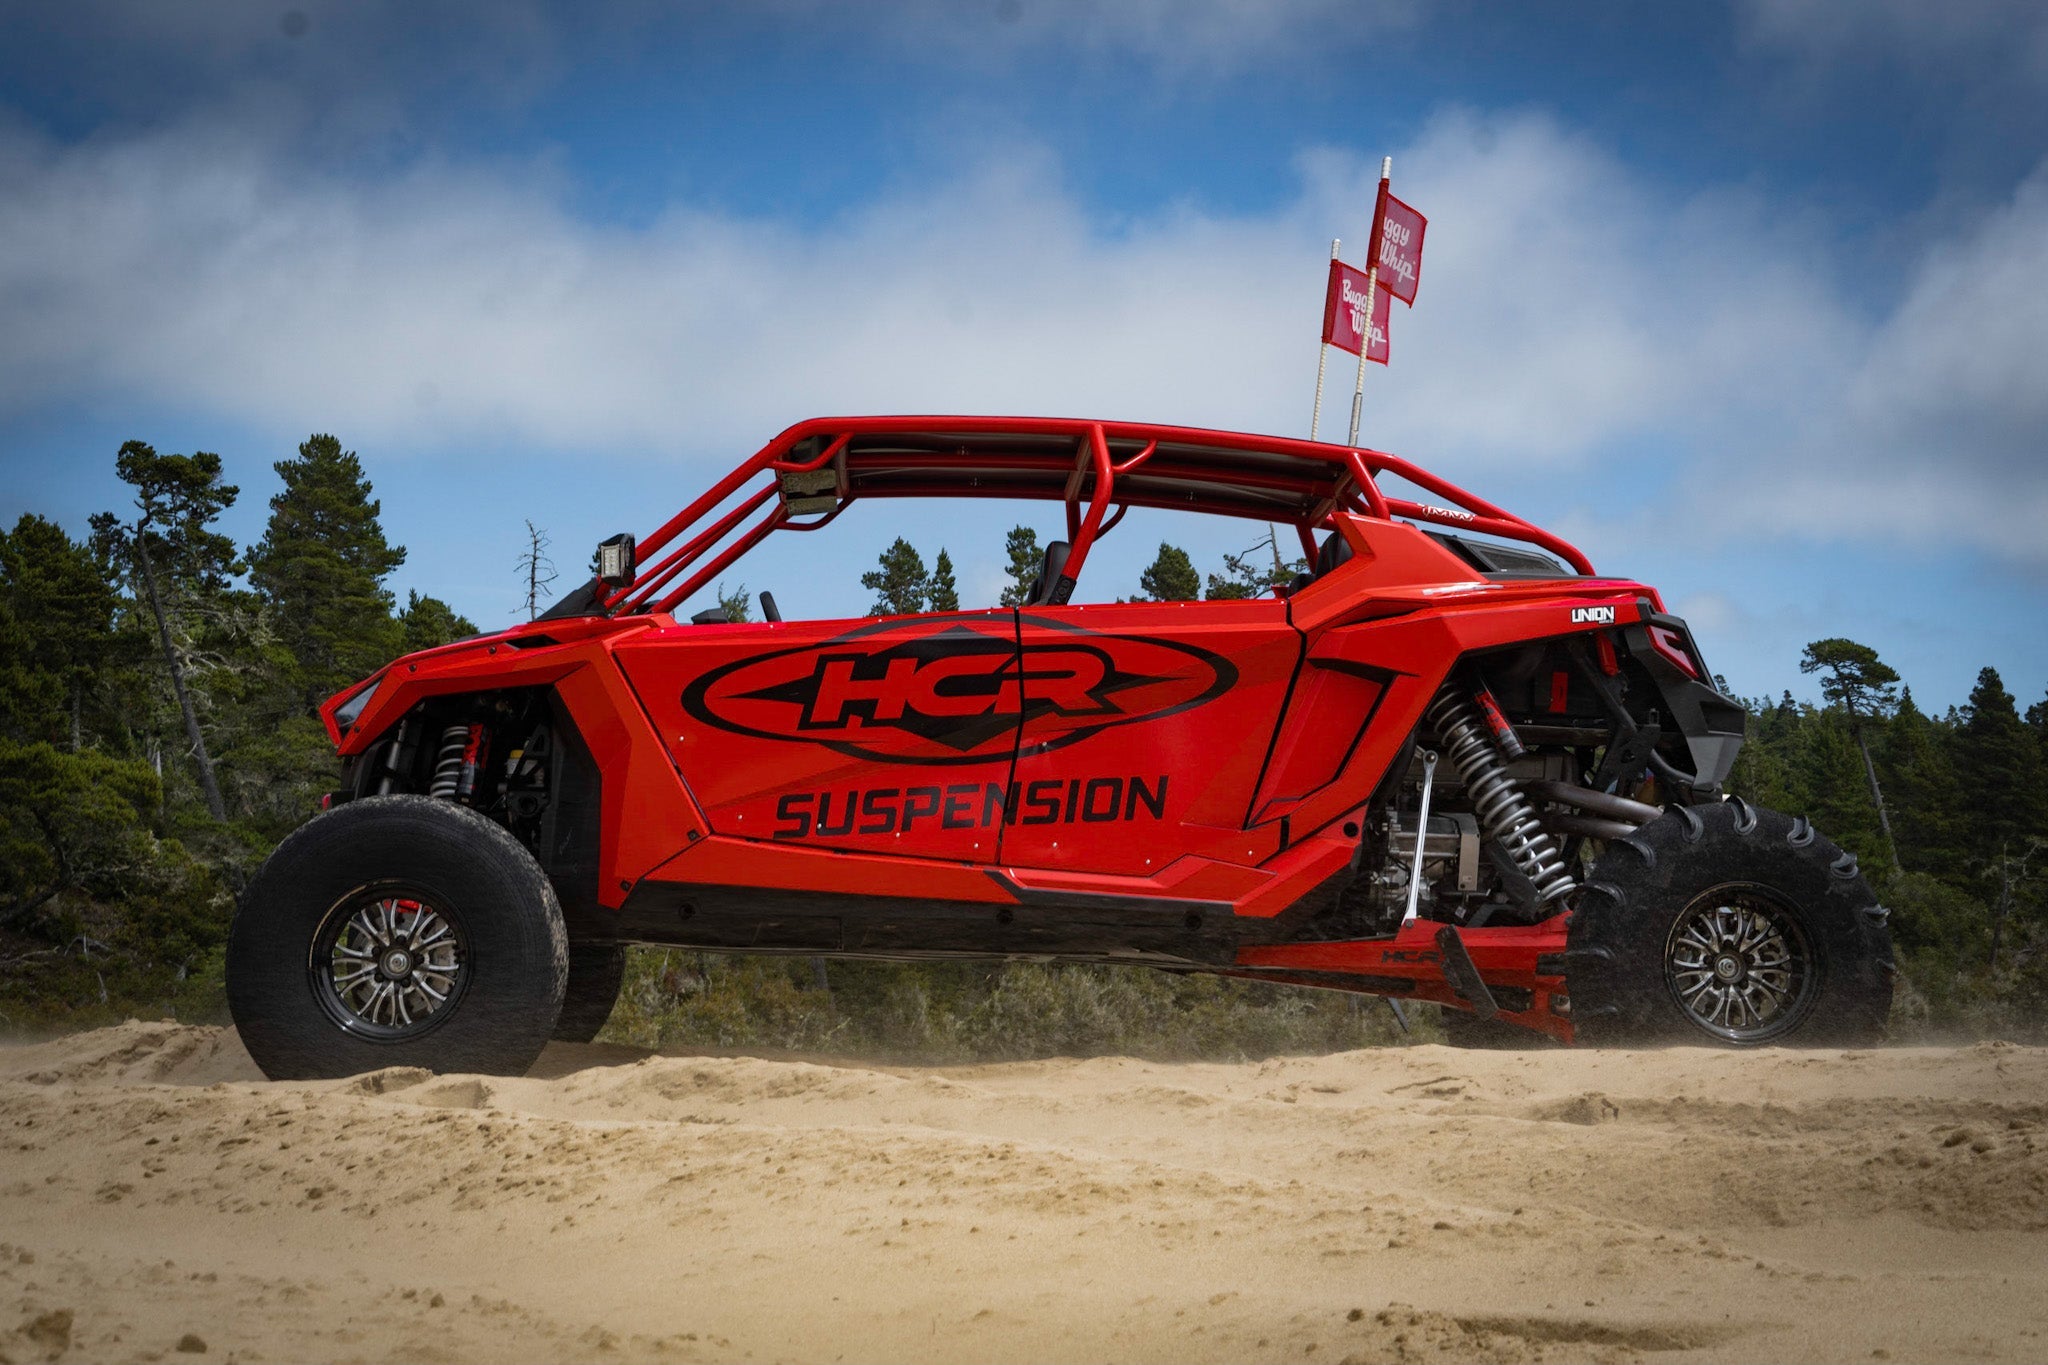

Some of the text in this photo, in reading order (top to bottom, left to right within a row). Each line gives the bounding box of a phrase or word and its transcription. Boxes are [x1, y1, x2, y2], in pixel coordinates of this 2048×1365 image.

[1379, 236, 1416, 283] Whip
[1342, 279, 1375, 316] Bugg
[1349, 309, 1387, 348] Wip
[1571, 606, 1615, 623] UNION
[801, 646, 1118, 728] HCR
[773, 774, 1169, 839] SUSPENSION
